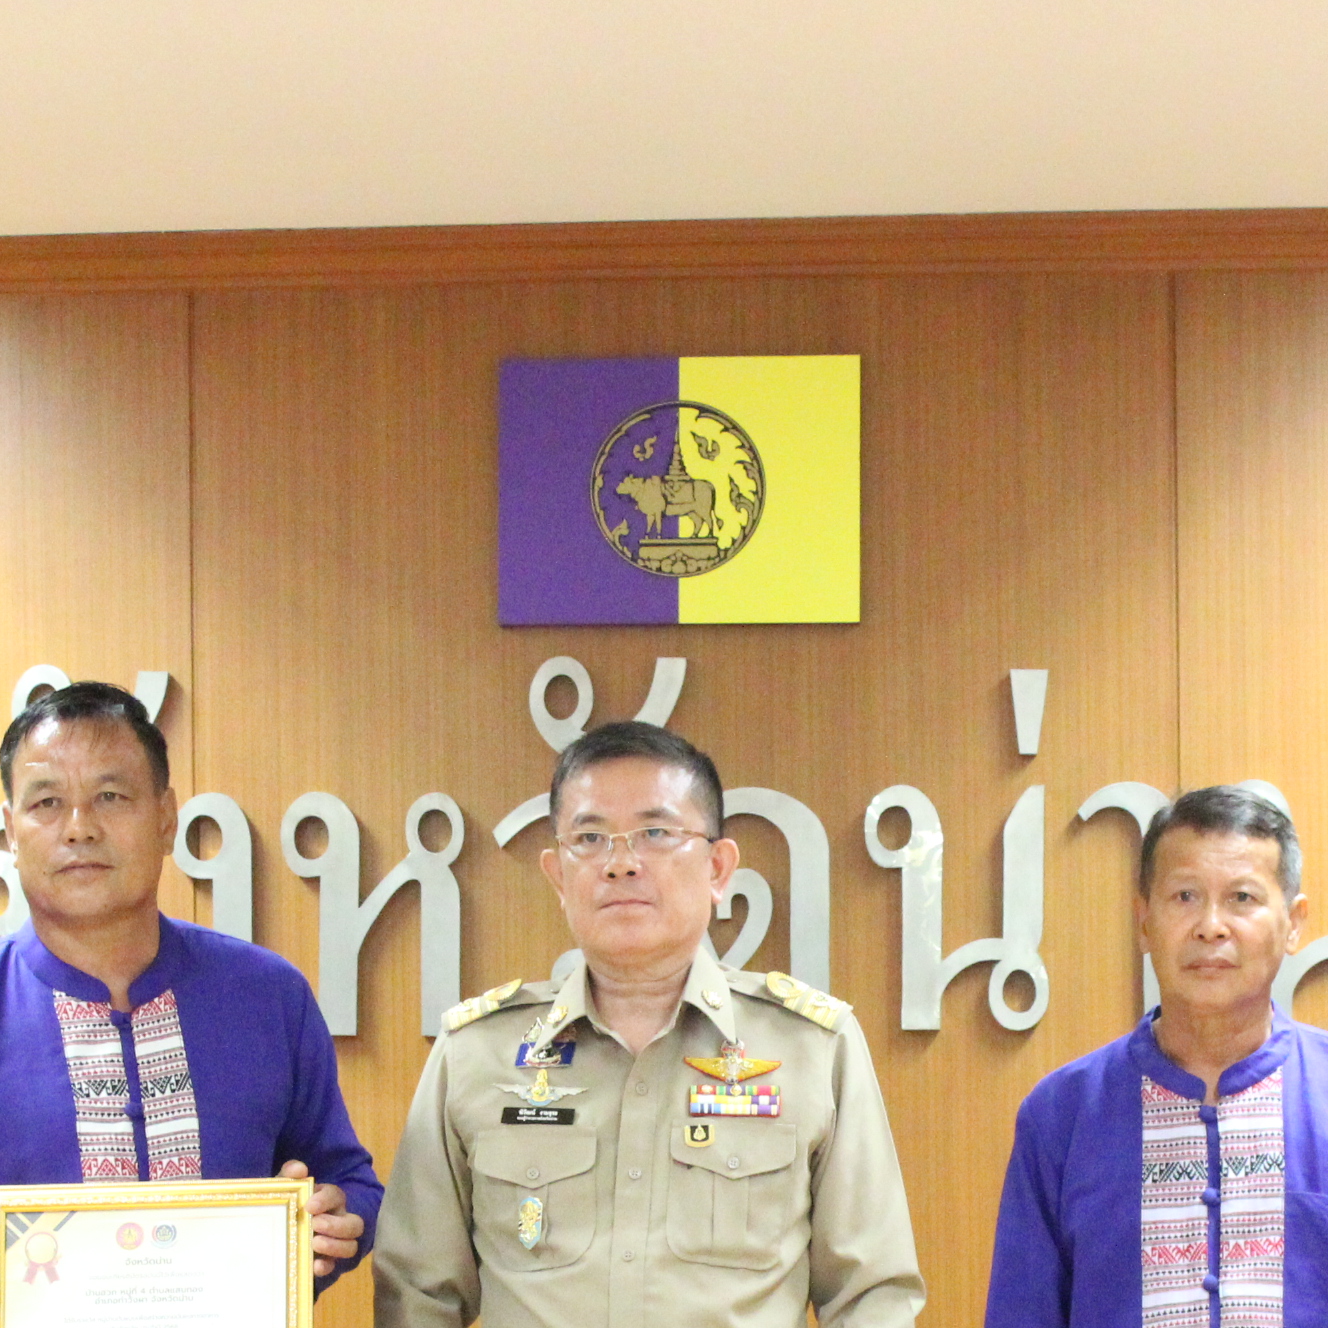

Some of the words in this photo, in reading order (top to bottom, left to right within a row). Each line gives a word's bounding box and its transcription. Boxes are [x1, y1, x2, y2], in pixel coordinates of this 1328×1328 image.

[125, 1256, 173, 1266] จังหวัดน่าน
[151, 1294, 194, 1303] จังหวัดน่าน
